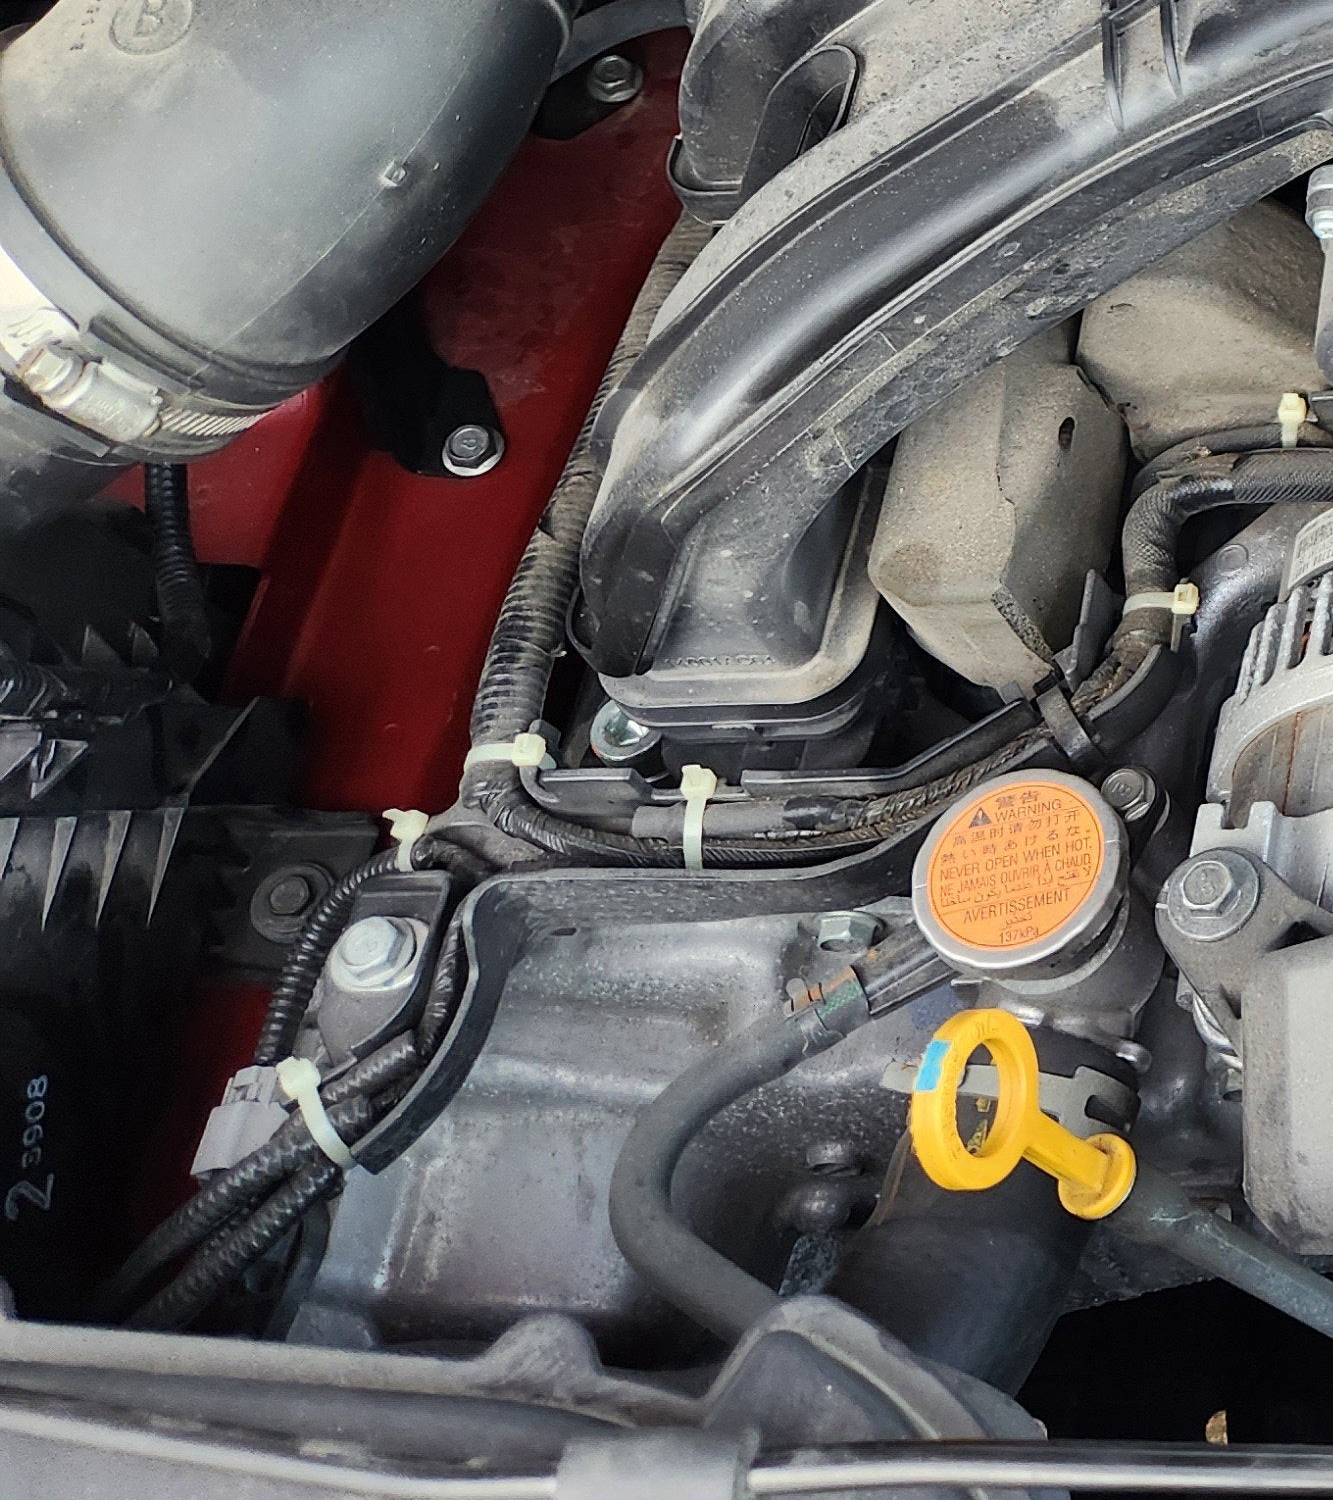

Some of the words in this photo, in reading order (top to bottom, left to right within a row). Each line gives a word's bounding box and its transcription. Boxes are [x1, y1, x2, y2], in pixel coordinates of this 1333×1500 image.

[994, 798, 1062, 823] WARNING
[940, 861, 981, 882] NEVER
[985, 855, 1019, 872] OPEN
[1023, 843, 1061, 863] WHEN
[1065, 837, 1093, 851] HOT.
[940, 884, 954, 898] NE
[957, 874, 997, 892] JAMAIS
[1000, 866, 1040, 884] OUVRIR
[963, 887, 1071, 924] AVERTISSEMENT
[999, 927, 1040, 944] 137kPa
